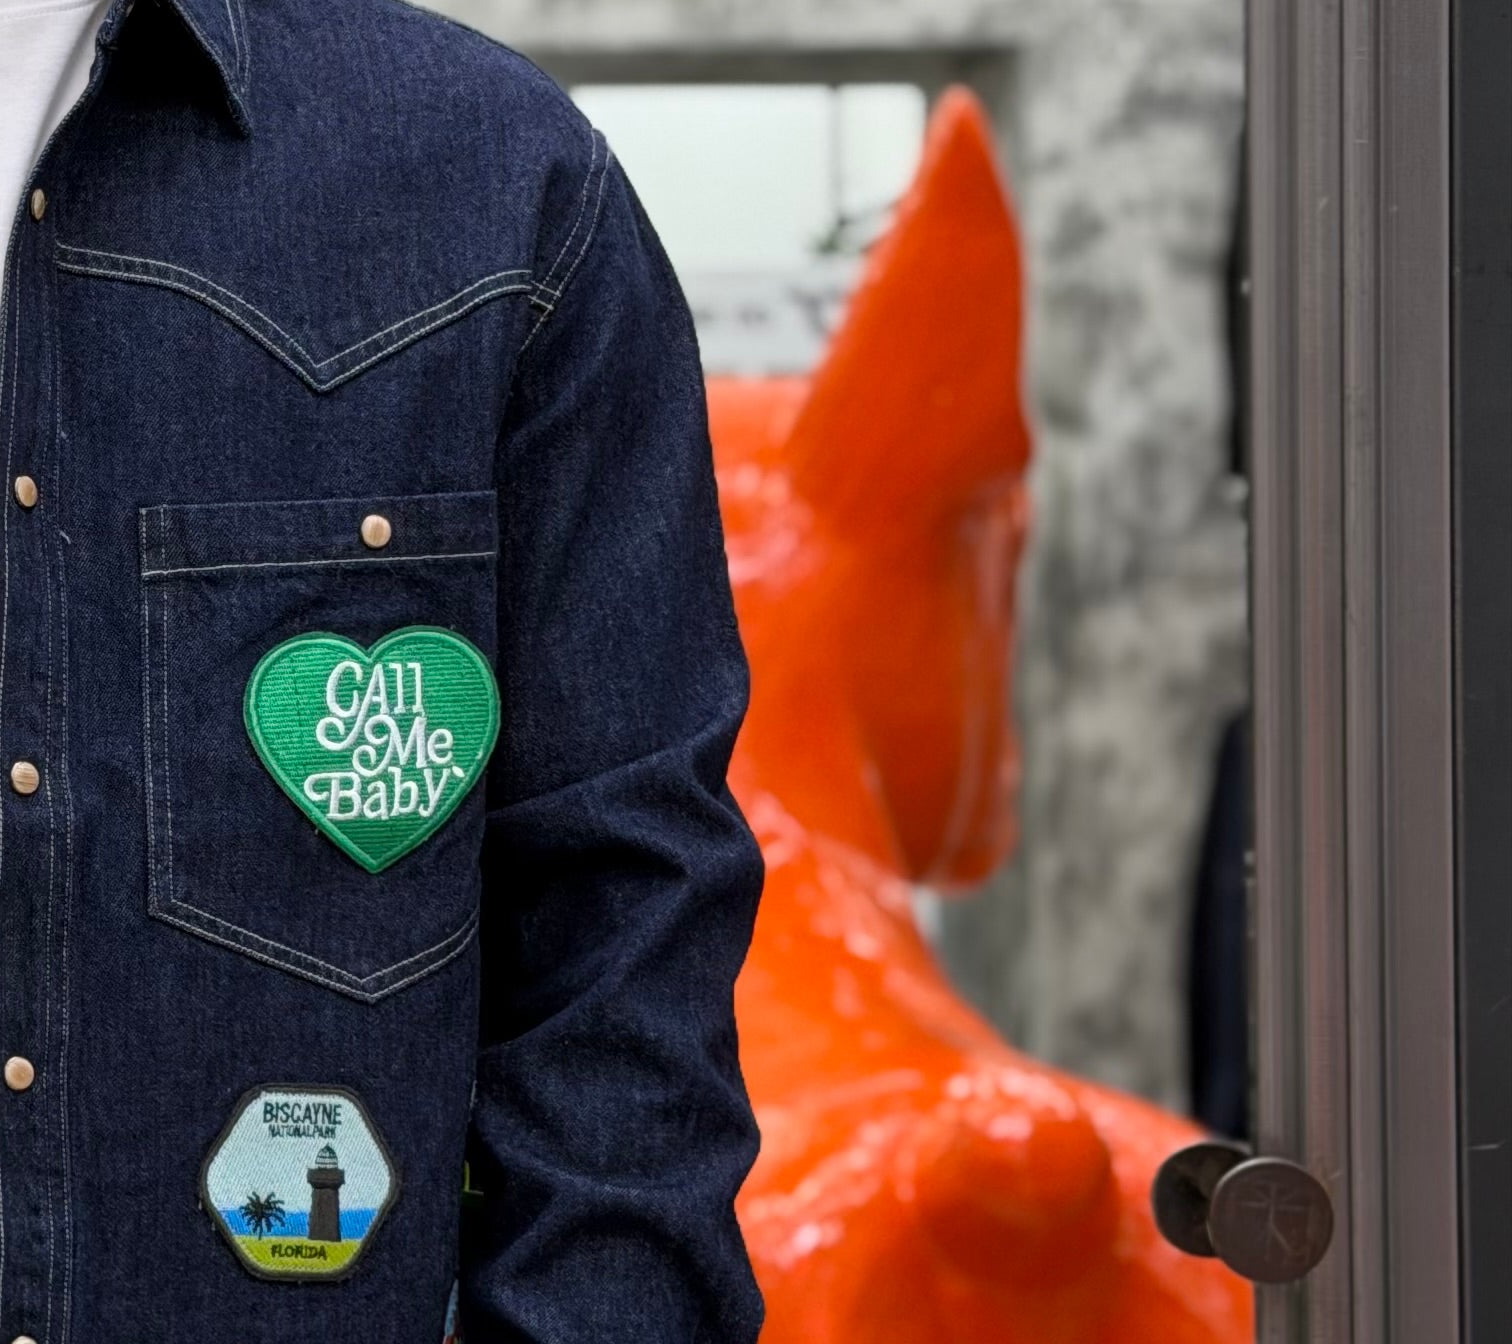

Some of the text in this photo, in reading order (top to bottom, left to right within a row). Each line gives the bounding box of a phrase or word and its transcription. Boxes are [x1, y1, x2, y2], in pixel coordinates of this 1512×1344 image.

[352, 714, 453, 777] Me
[263, 1102, 342, 1125] BISCAYNE
[272, 1244, 327, 1260] FLORIDA
